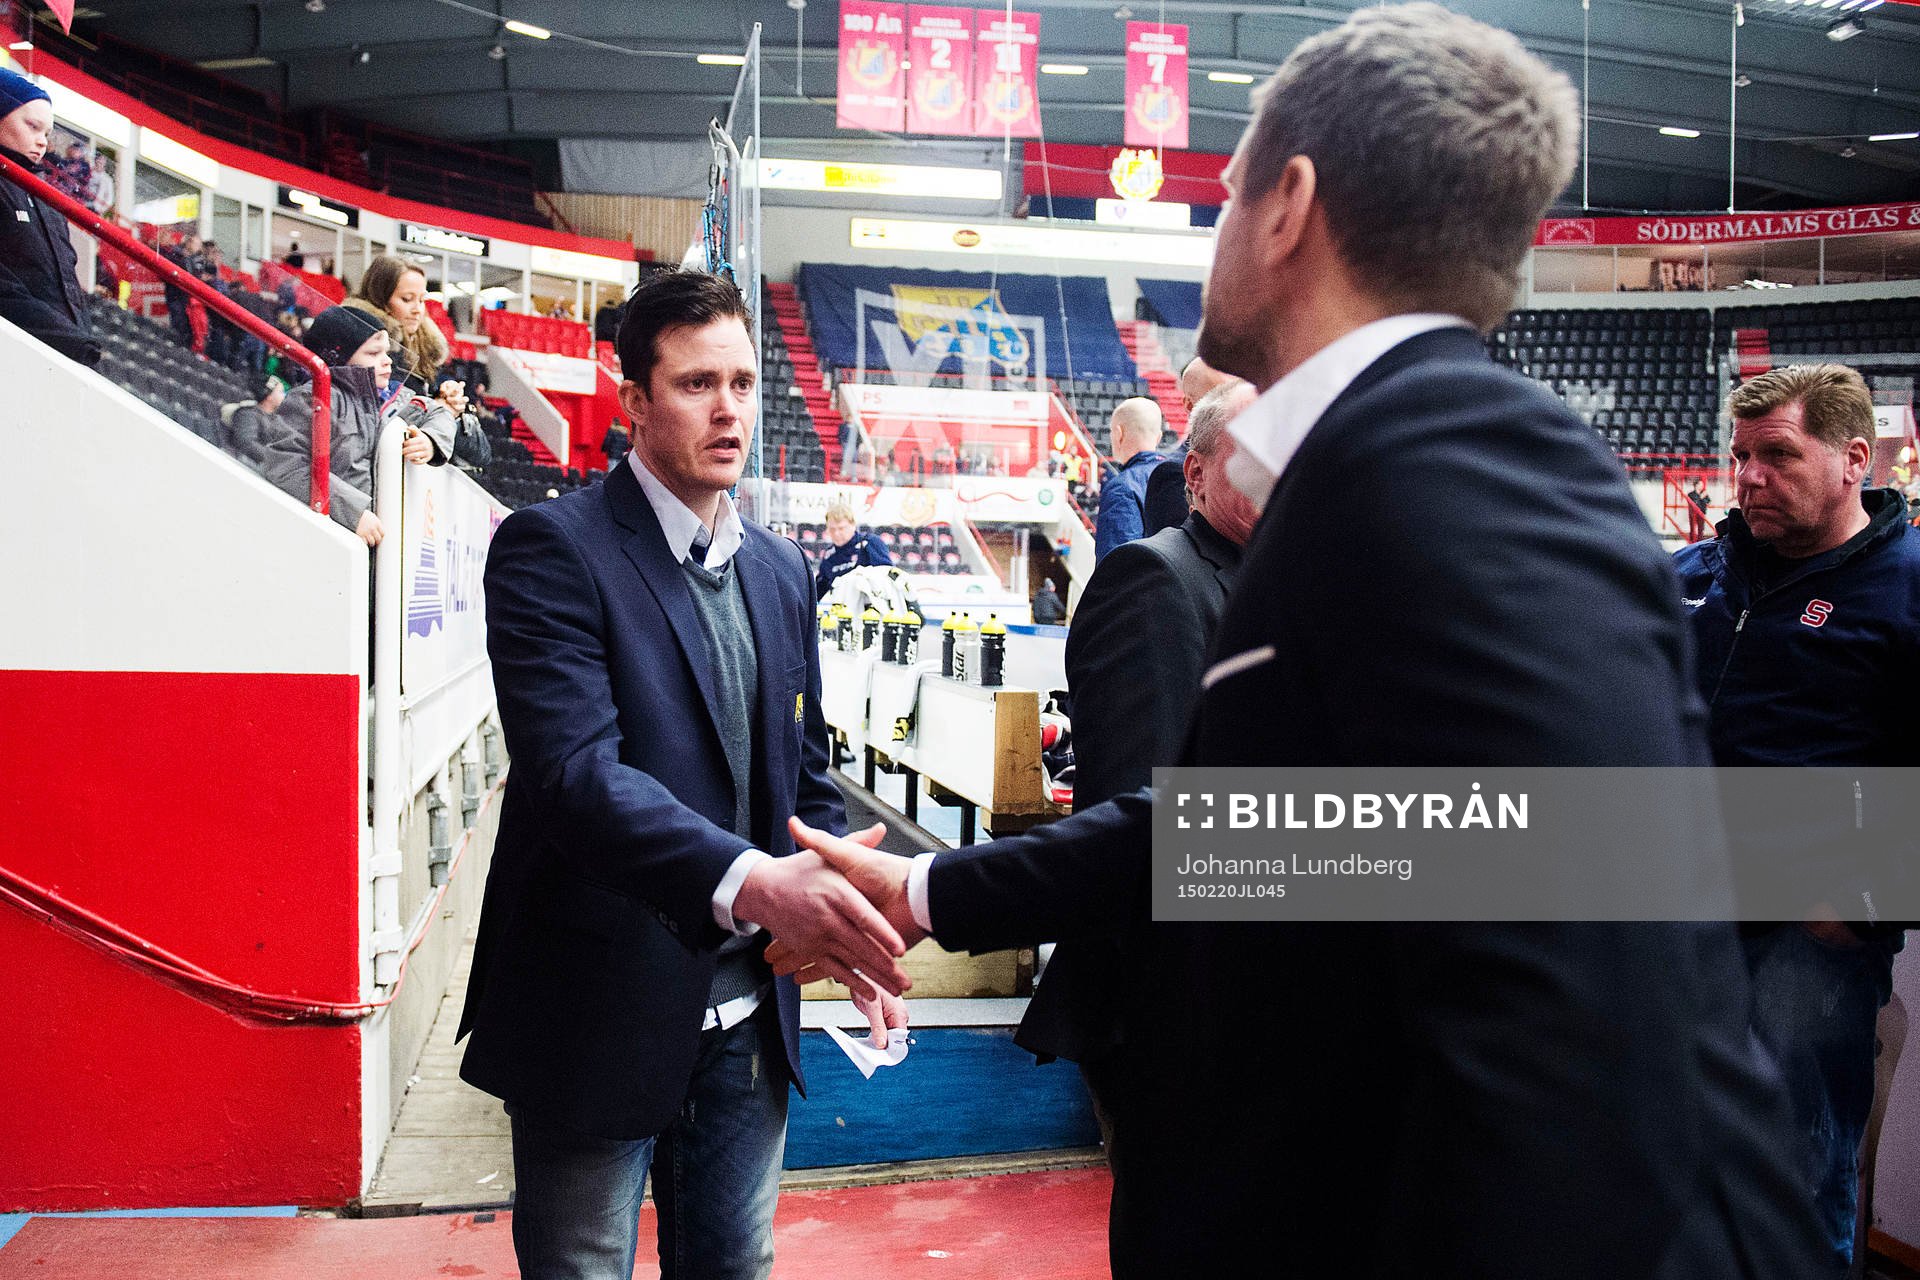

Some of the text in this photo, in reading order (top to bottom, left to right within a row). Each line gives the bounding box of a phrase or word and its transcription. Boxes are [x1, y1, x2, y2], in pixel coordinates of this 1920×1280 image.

[930, 38, 951, 68] 2
[1146, 53, 1167, 84] 7
[1637, 214, 1820, 241] SÖDERMALMS
[1827, 209, 1900, 231] GLAS
[1800, 599, 1834, 628] S
